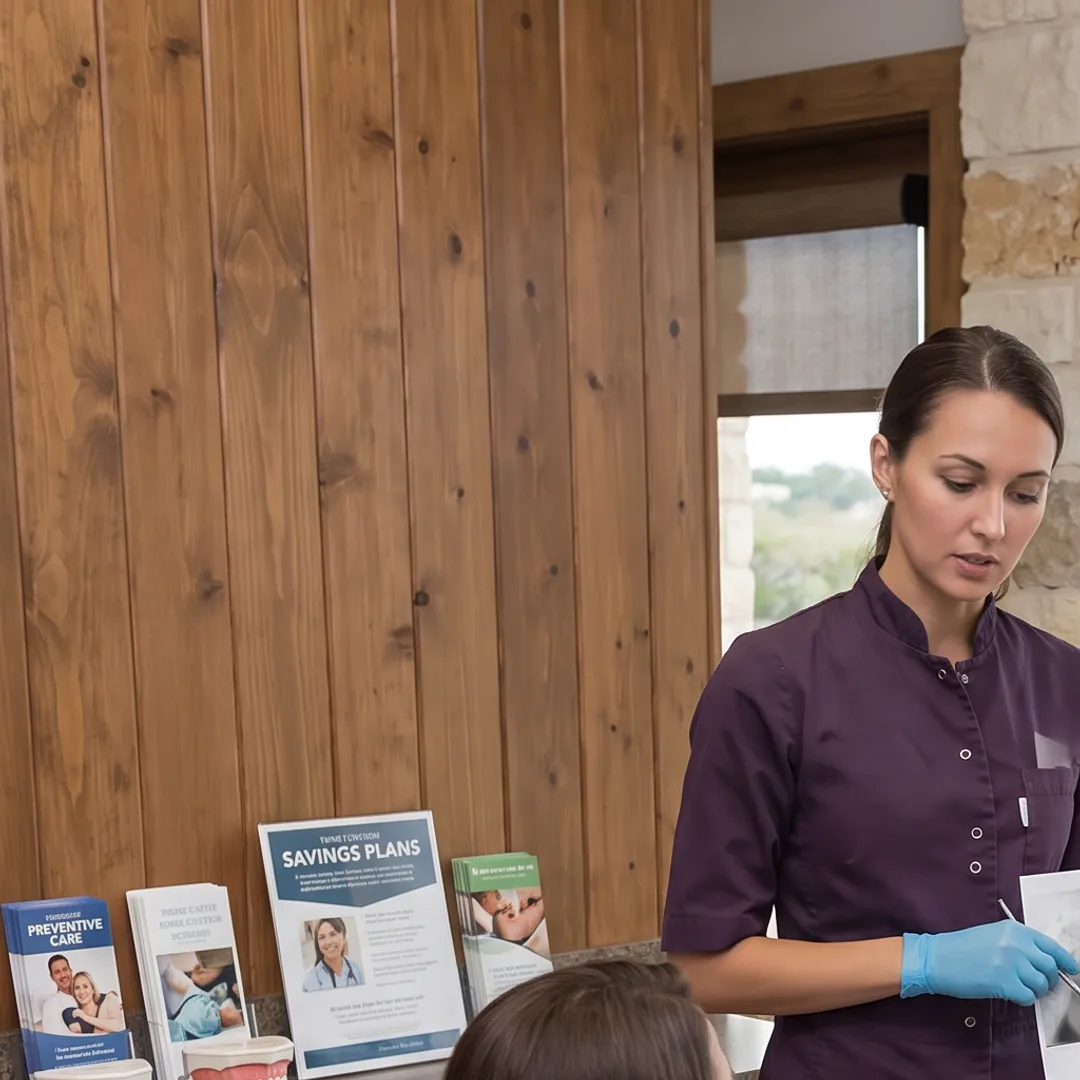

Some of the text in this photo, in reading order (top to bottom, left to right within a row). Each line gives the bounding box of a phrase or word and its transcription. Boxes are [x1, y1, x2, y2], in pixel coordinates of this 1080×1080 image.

[282, 839, 421, 869] SAVINGS PLANS
[27, 918, 103, 937] PREVENTIVE
[49, 932, 83, 947] CARE
